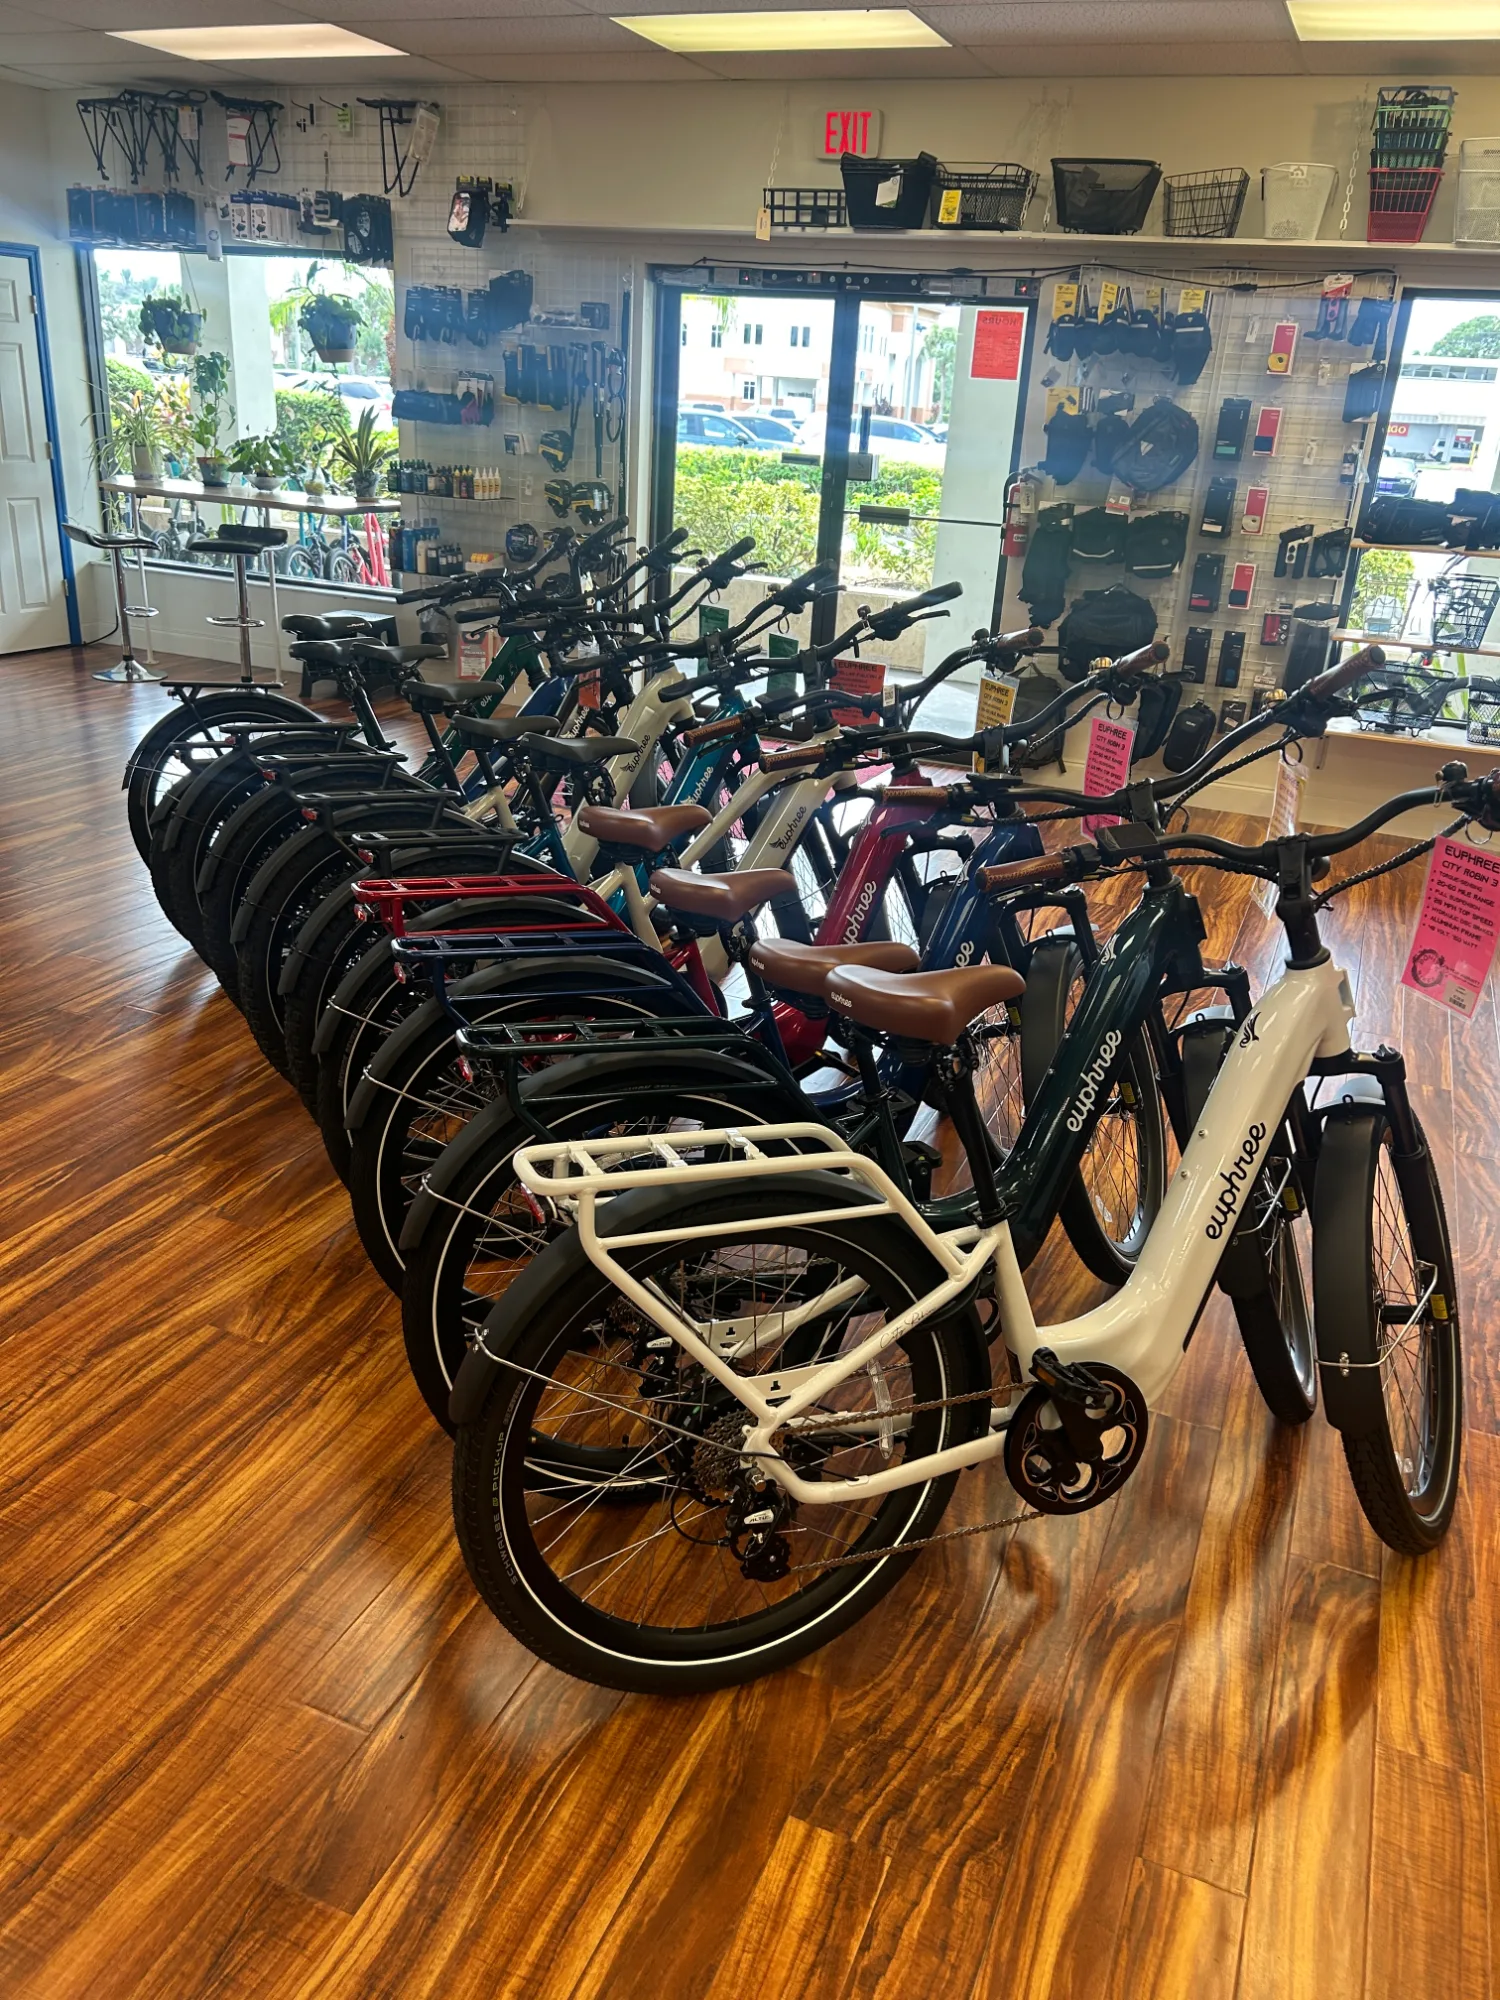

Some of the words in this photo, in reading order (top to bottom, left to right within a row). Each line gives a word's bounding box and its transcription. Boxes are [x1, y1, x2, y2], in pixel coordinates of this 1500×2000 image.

[824, 111, 872, 154] EXIT
[838, 661, 878, 672] EUPHREE
[985, 682, 1010, 697] EUPHREE
[1096, 735, 1107, 743] CITY
[1098, 723, 1128, 740] EUPHREE
[628, 734, 651, 773] euphree
[777, 805, 807, 850] euphree
[1442, 860, 1462, 873] CITY
[1463, 868, 1489, 883] ROBIN
[1491, 879, 1499, 887] 3
[1445, 845, 1500, 874] EUPHREE
[1434, 889, 1448, 898] FULL
[1436, 879, 1457, 892] 20-60
[1458, 888, 1472, 898] MILE
[1473, 895, 1495, 908] RANGE
[843, 880, 877, 945] phree
[1443, 902, 1457, 911] MPH
[1458, 907, 1471, 916] TOP
[1472, 913, 1494, 927] SPEED
[1430, 916, 1460, 932] ALUMINUM
[1460, 927, 1482, 941] FRAME
[1437, 928, 1450, 937] VOLT
[1463, 939, 1478, 949] WATT
[830, 991, 852, 1008] euphree
[1067, 1029, 1122, 1132] euphree
[1205, 1122, 1266, 1240] euphree
[492, 1431, 505, 1492] PICK-UP
[494, 1513, 519, 1585] SCHWALBE
